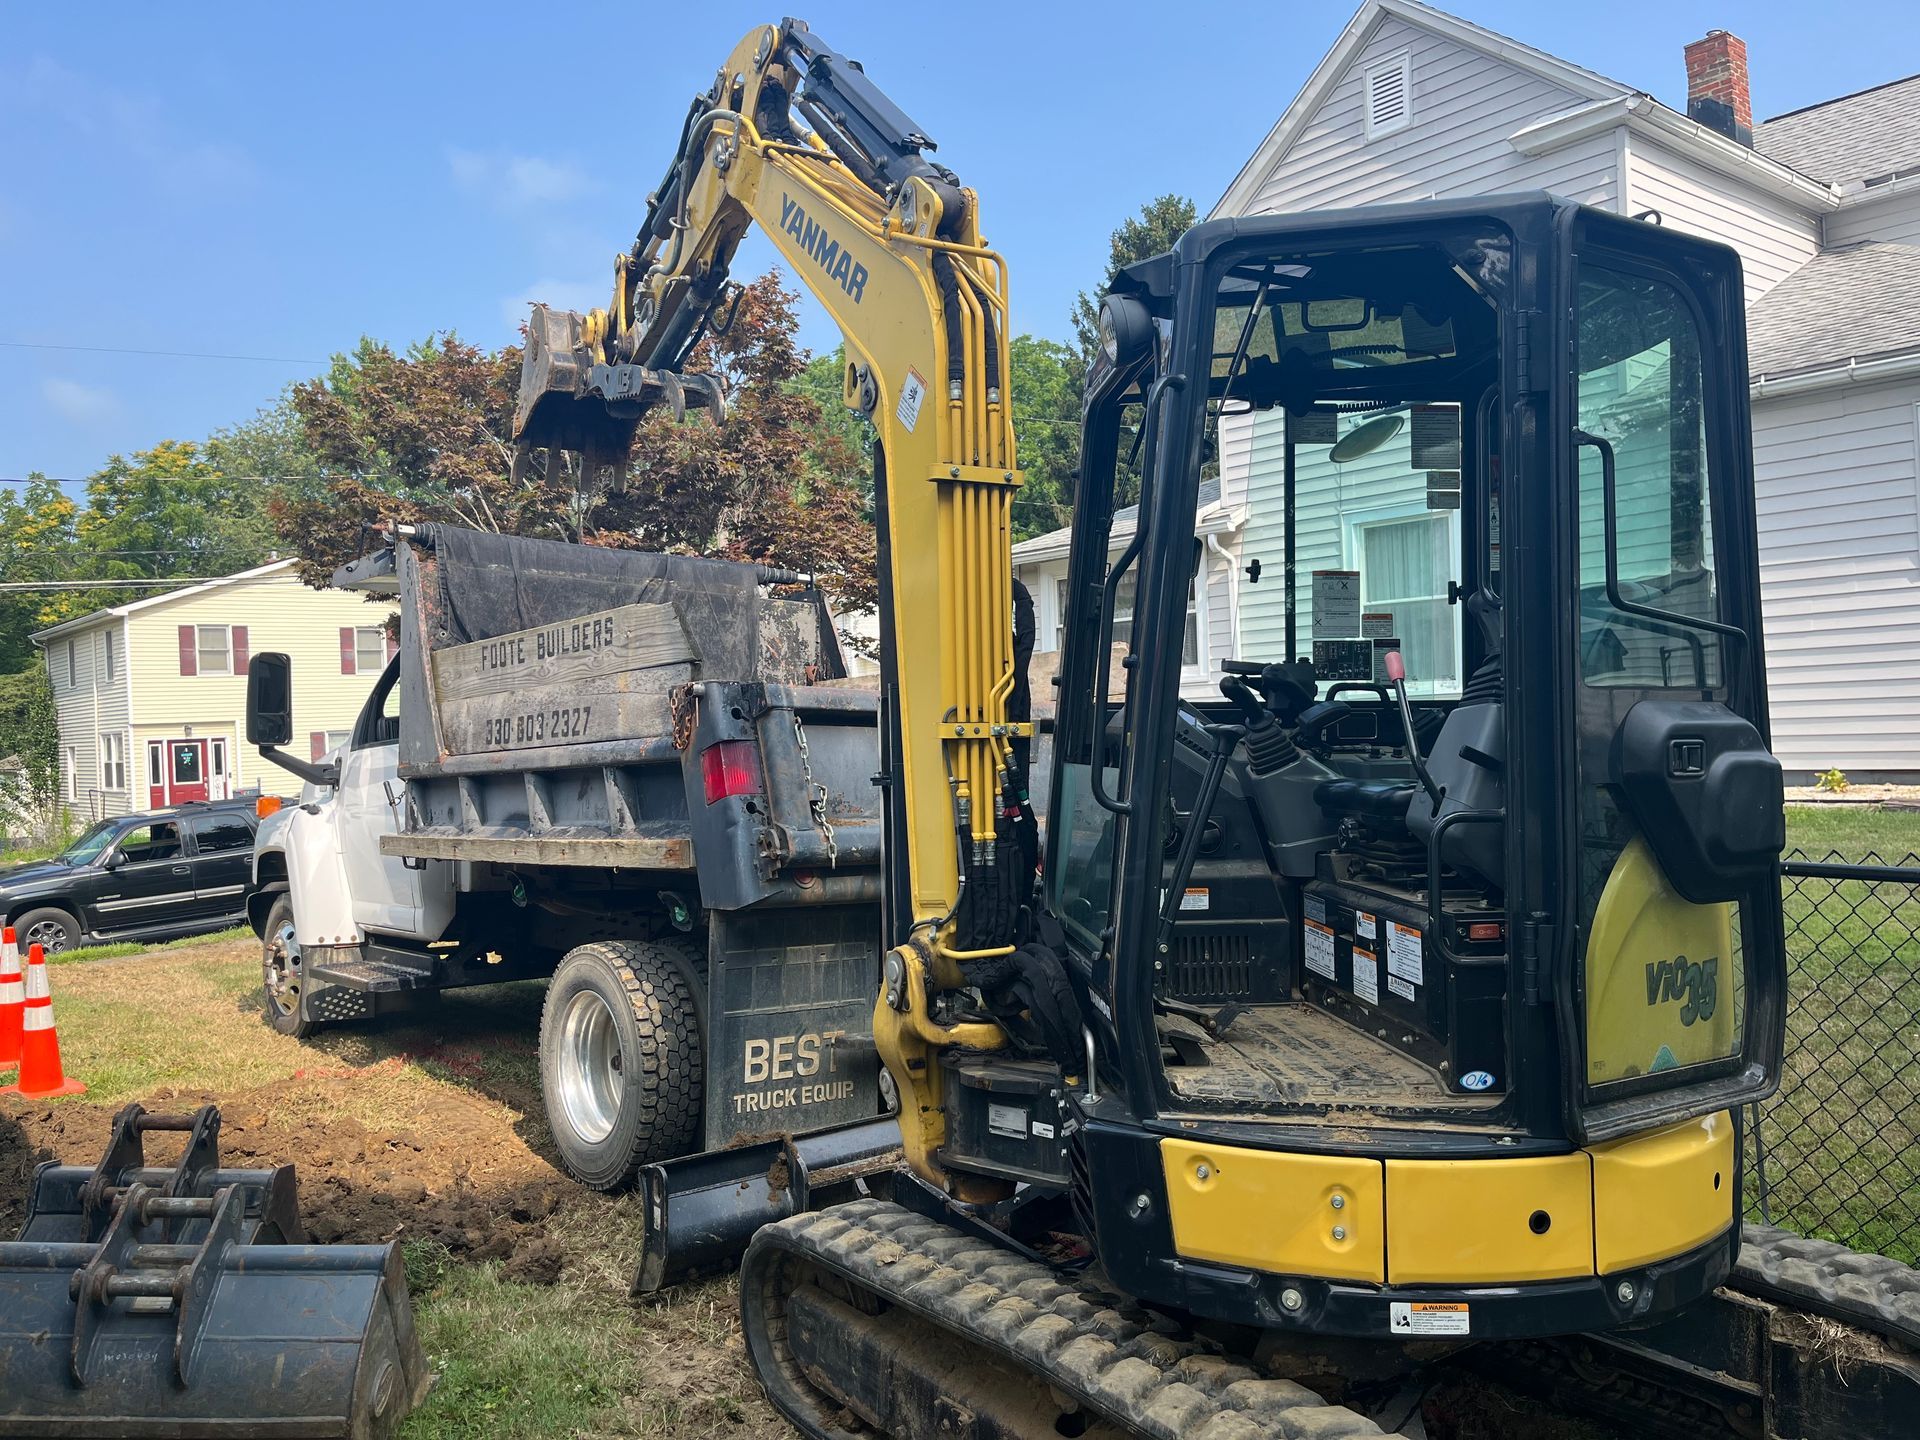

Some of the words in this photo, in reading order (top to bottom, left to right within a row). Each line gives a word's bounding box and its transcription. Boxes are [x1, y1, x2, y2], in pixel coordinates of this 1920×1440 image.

[779, 191, 869, 305] YANMAR
[481, 637, 526, 671] FOOTE
[537, 617, 613, 660] BUILDERS
[744, 1029, 846, 1084] BEST
[733, 1087, 797, 1114] TRUCK
